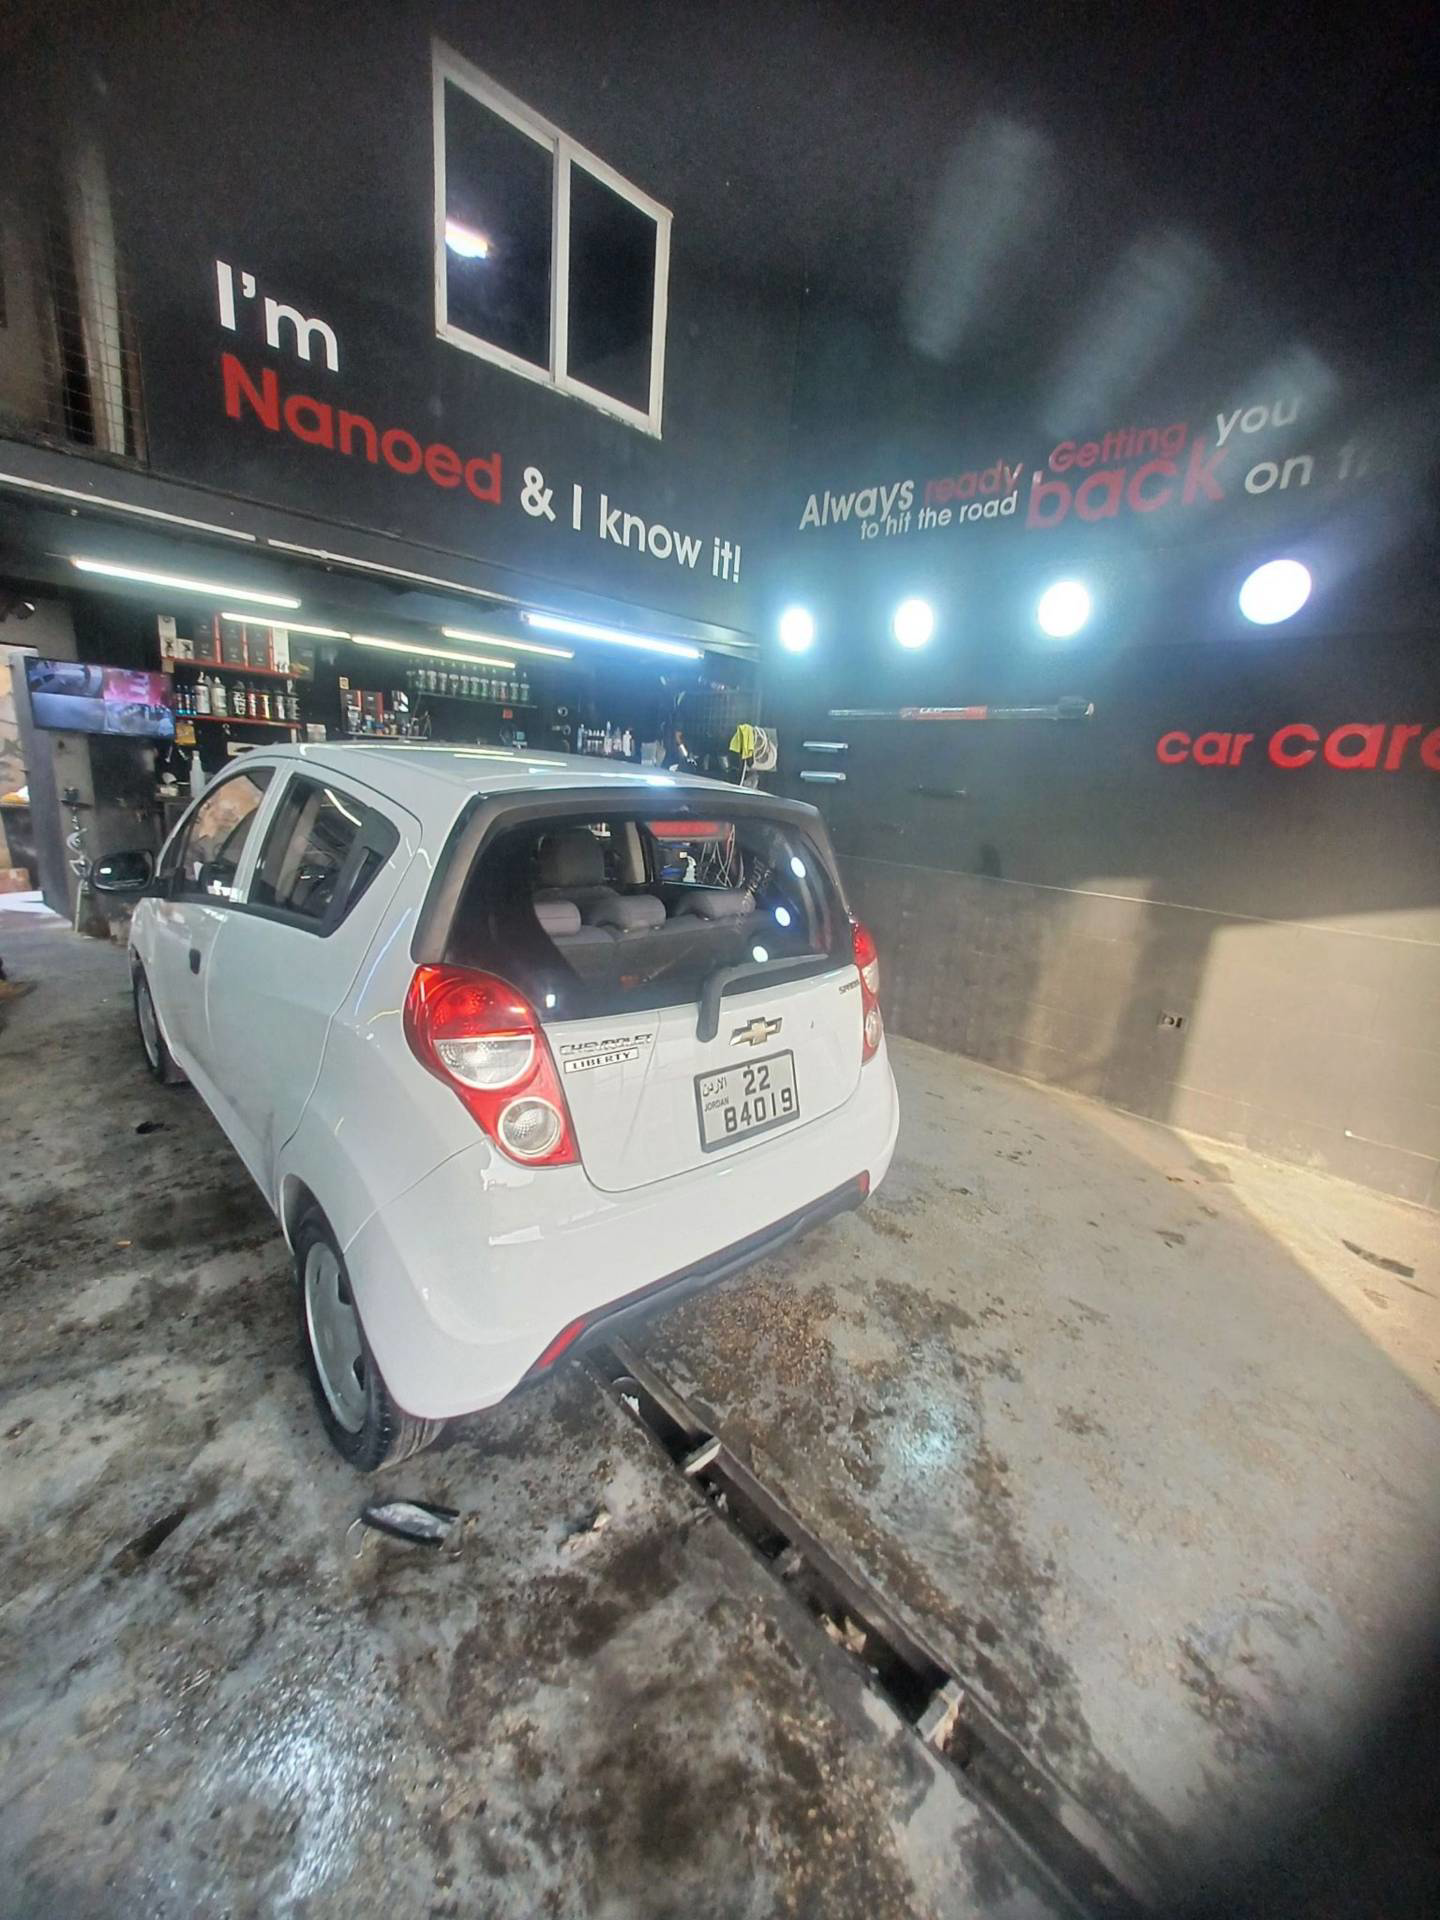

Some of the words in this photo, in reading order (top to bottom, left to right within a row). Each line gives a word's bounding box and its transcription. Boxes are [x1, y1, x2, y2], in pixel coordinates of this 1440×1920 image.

[216, 259, 339, 372] I'm
[1049, 422, 1188, 472] Getting
[1216, 399, 1299, 446] you
[221, 351, 502, 504] Nanoed
[520, 466, 556, 522] &
[573, 483, 582, 531] I
[600, 493, 702, 569] know
[712, 536, 741, 583] it!
[799, 480, 914, 530] Always
[924, 459, 1023, 505] ready
[1025, 436, 1230, 529] back
[1244, 454, 1314, 494] on
[861, 519, 879, 540] to
[886, 511, 911, 536] hit
[918, 506, 952, 531] the
[959, 490, 1018, 523] road
[1156, 730, 1254, 767] car
[572, 1051, 630, 1070] LIBERTY
[743, 1065, 770, 1096] 22
[723, 1087, 793, 1133] 84019
